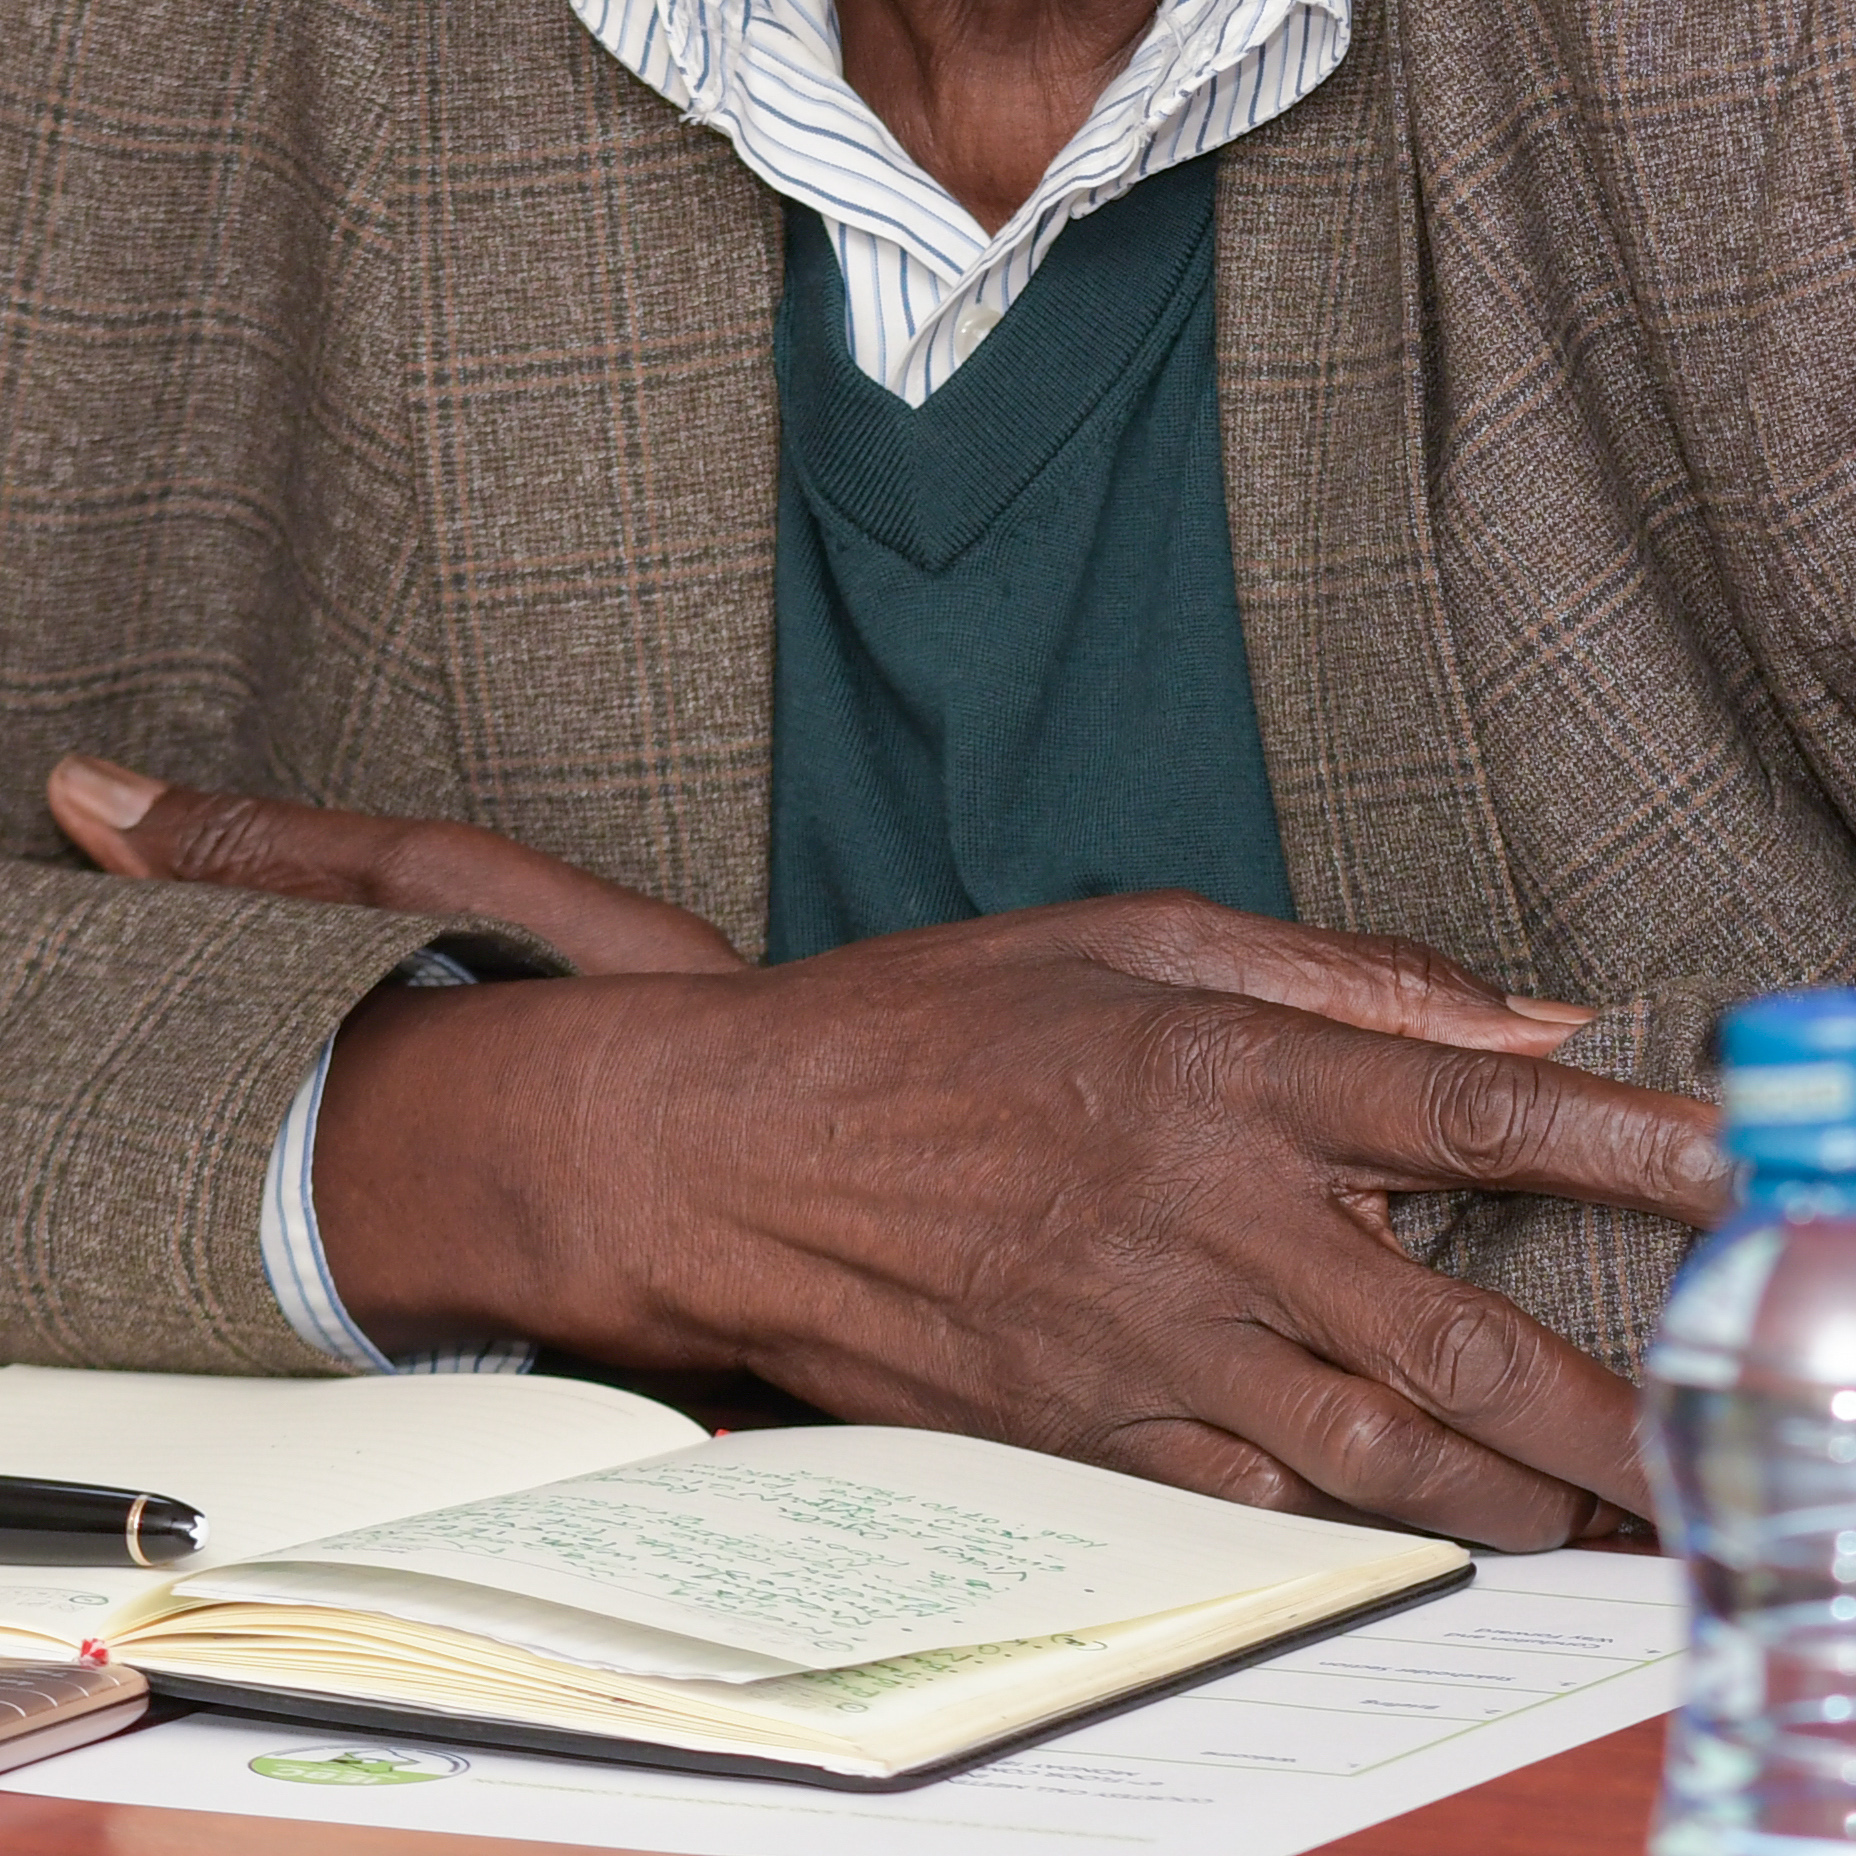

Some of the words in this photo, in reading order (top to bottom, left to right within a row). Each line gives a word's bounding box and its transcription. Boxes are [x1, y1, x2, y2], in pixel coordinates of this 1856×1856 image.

[1473, 1628, 1564, 1639] Forward
[1491, 1636, 1601, 1649] Conclusion
[1568, 1635, 1614, 1644] Way
[1319, 1662, 1392, 1672] Section
[1395, 1669, 1516, 1682] Stakeholder
[1359, 1699, 1441, 1709] Briefing
[1200, 1751, 1297, 1763] Welcome
[1027, 1764, 1141, 1776] MONDAY
[270, 1768, 382, 1785] IEBC
[1044, 1772, 1125, 1783] FLOOR
[1037, 1786, 1088, 1795] CALL
[1094, 1793, 1214, 1803] COURTESY
